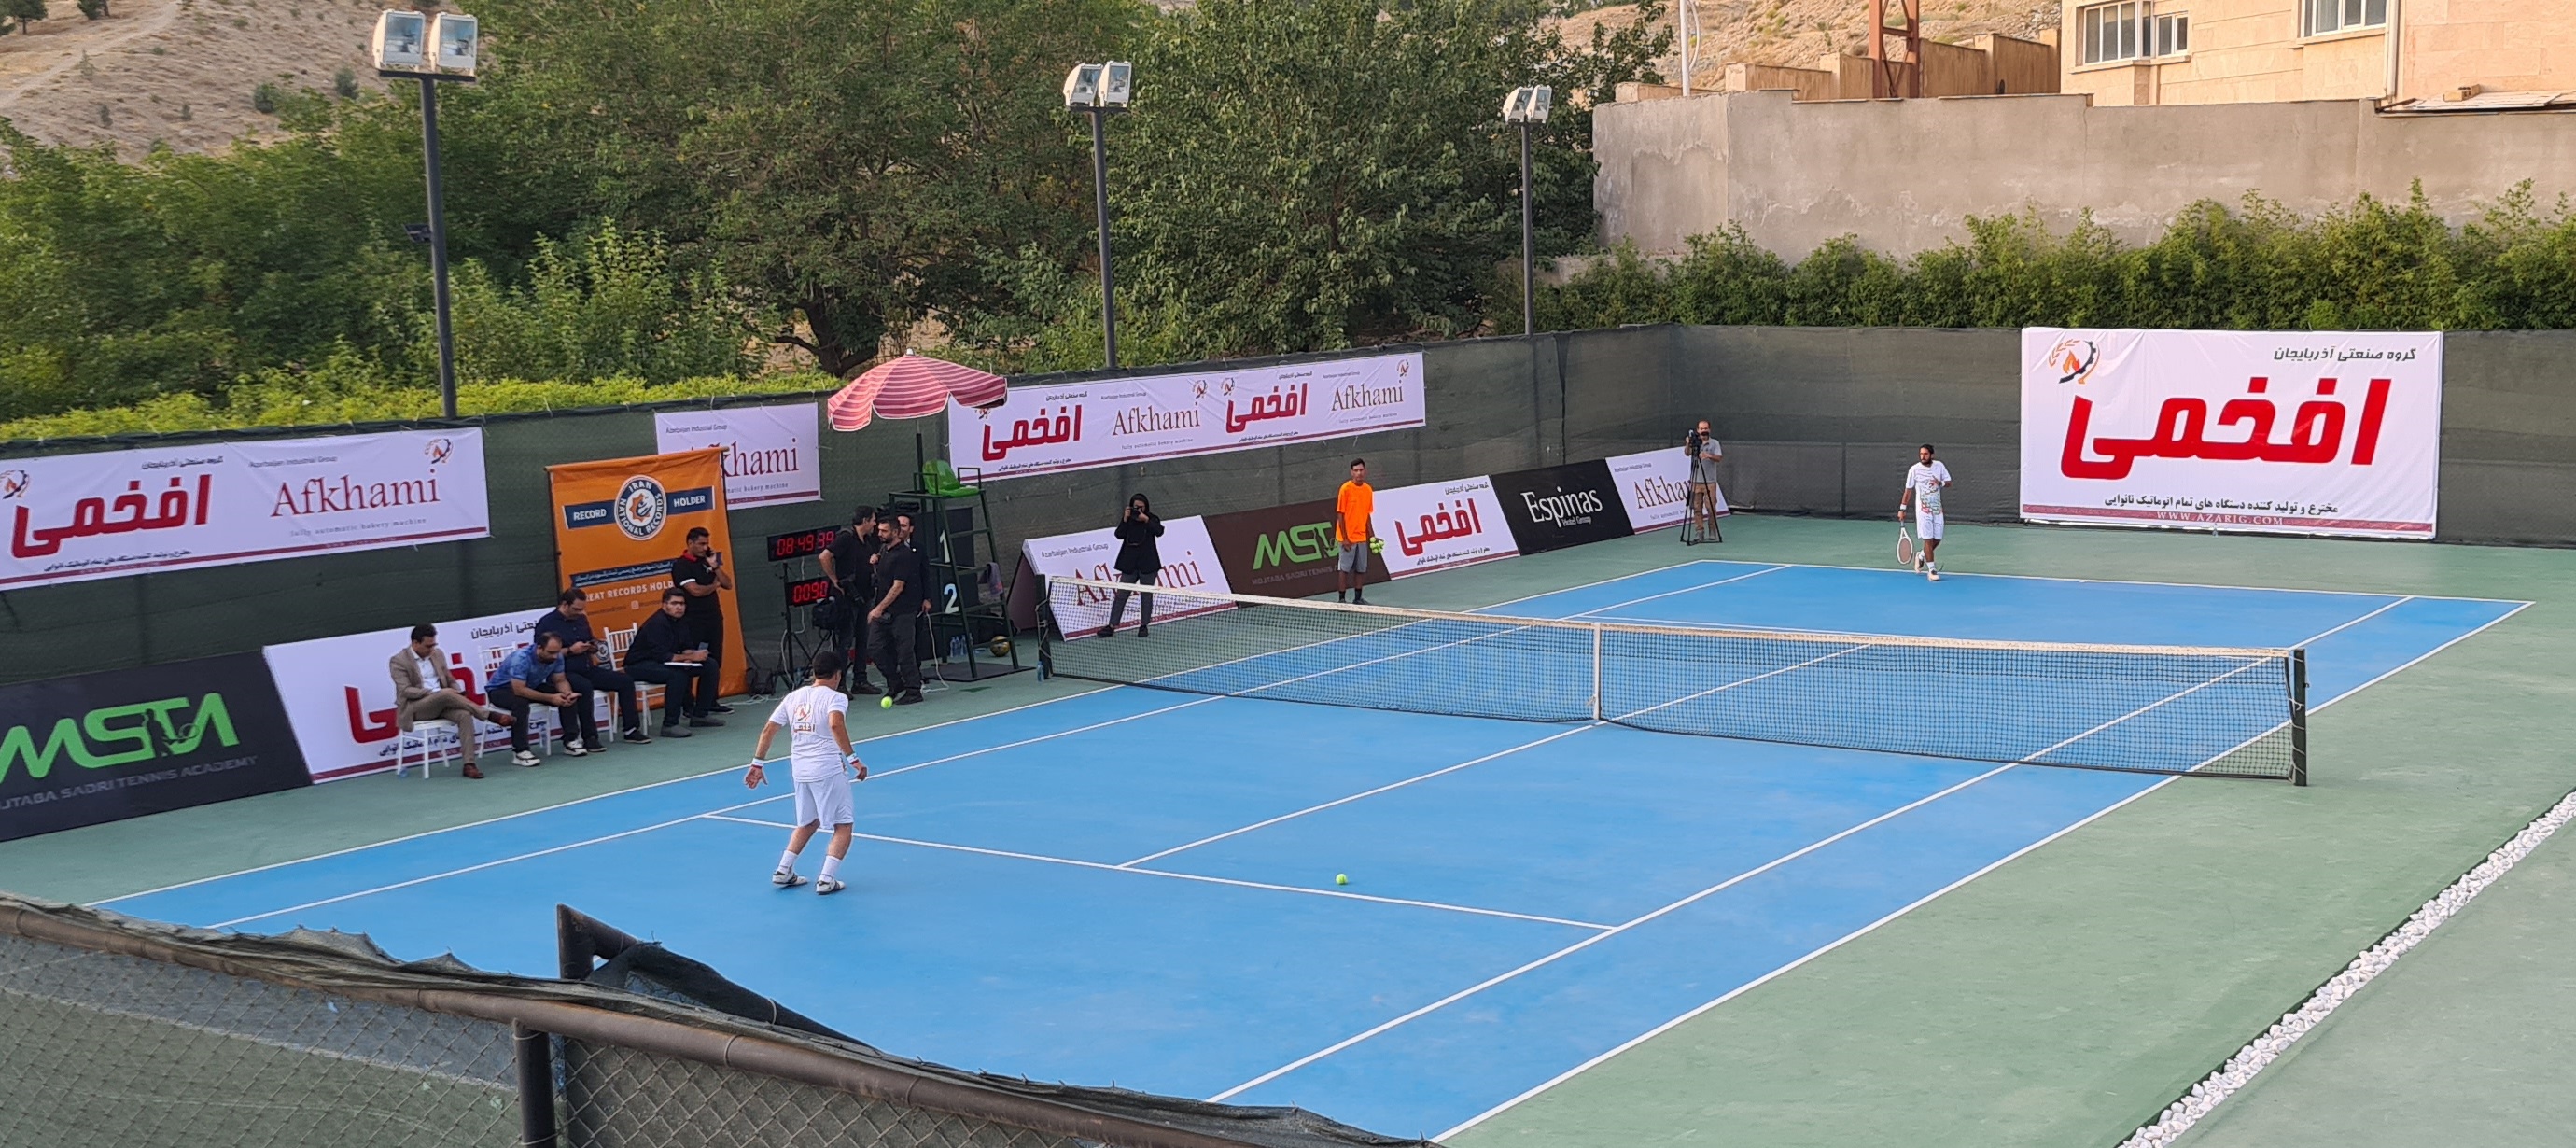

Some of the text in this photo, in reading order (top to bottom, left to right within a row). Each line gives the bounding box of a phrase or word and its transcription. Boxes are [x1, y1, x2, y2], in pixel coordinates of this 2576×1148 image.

[2274, 345, 2416, 361] گروه صنعتی آذربایجان
[1226, 383, 1308, 434] افخمی
[1331, 379, 1404, 411] Afkhami
[982, 404, 1082, 461] افخمی
[1113, 401, 1201, 436] Afkhami
[2060, 376, 2392, 479] افخمی
[270, 469, 441, 518] Afkhami
[629, 481, 652, 493] IRAN
[673, 495, 706, 507] HOLDER
[1634, 475, 1691, 509] Afkha
[2104, 493, 2339, 516] مخترع و تولید کننده دستگاه های تمام اتوماتیک نانوایی
[11, 473, 212, 558] افخمی
[573, 509, 607, 521] RECORD
[618, 493, 664, 536] NATIONAL RECORDS
[1520, 486, 1603, 528] Espinas
[1394, 497, 1482, 557] افخمی
[940, 529, 950, 564] 1
[585, 581, 674, 602] REAT RECORDS HOLD
[944, 583, 959, 614] 2
[0, 693, 240, 785] MSTA
[60, 779, 115, 799] SADRI
[116, 768, 177, 786] TENNIS
[180, 756, 259, 777] ACADEMY
